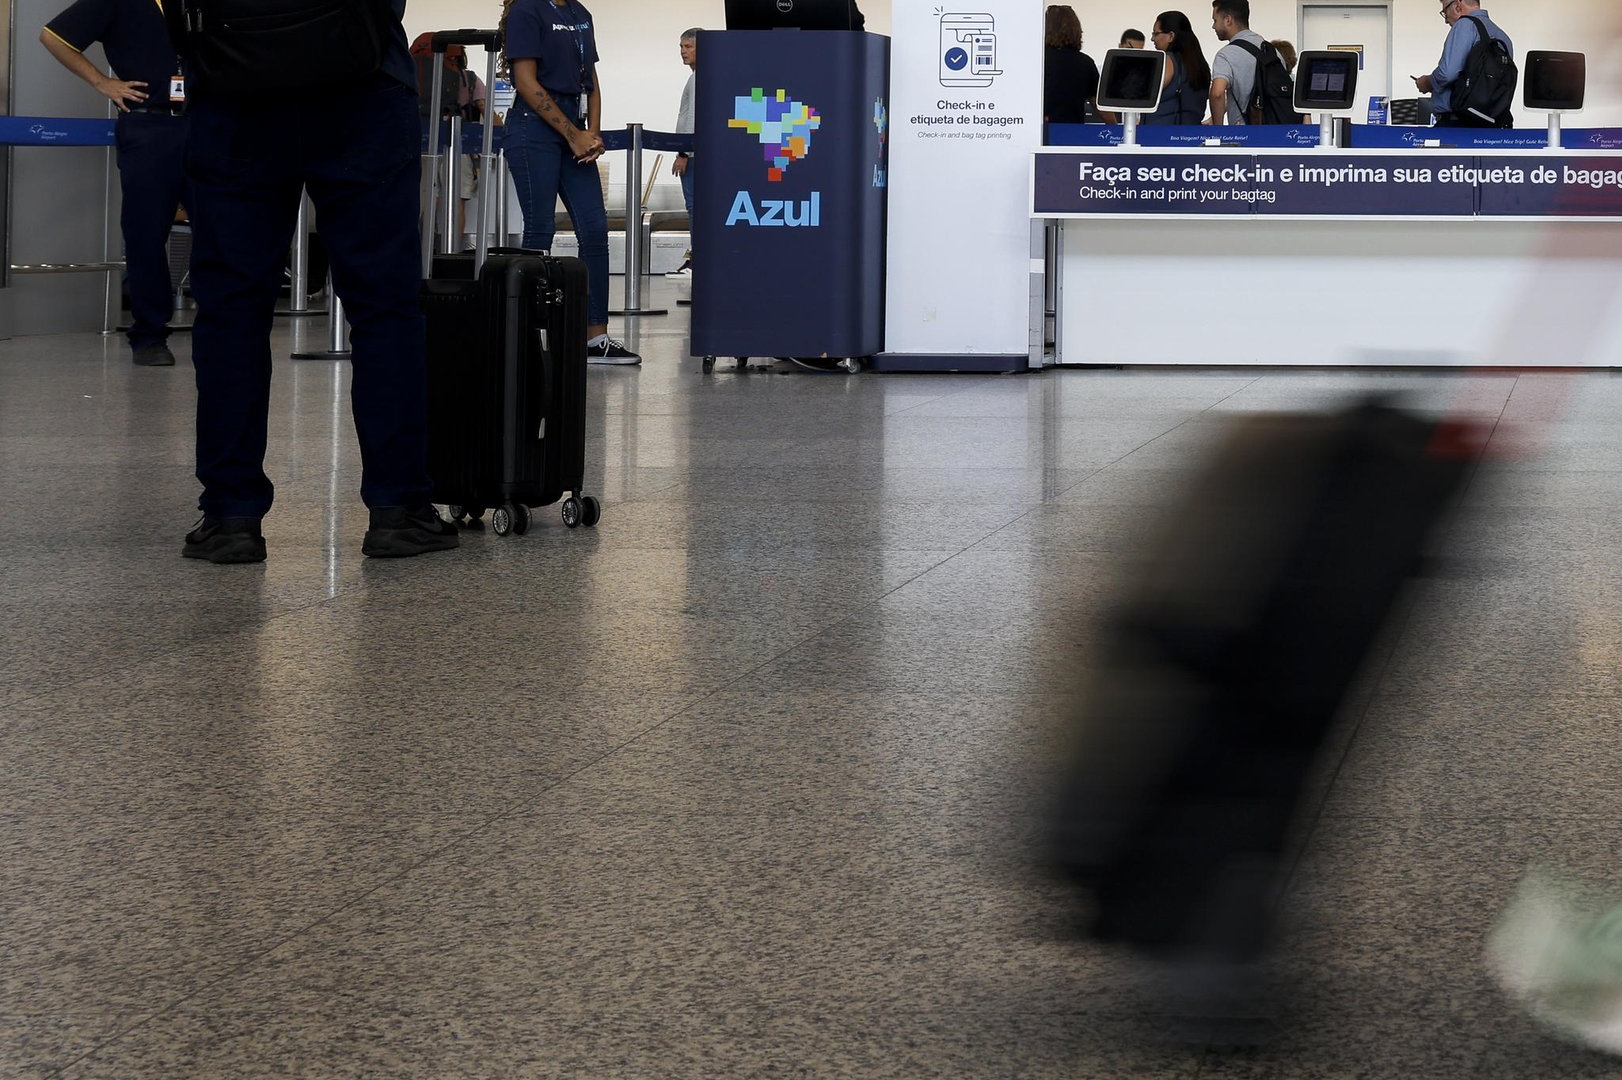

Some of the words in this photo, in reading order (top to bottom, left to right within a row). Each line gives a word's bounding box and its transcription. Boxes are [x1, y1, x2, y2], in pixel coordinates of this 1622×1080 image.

[937, 100, 985, 109] Check-in
[911, 115, 953, 126] etiqueta
[957, 115, 970, 124] de
[973, 115, 1023, 126] bagagem
[917, 131, 947, 139] Check-in
[948, 131, 960, 139] and
[961, 131, 974, 140] bag
[975, 131, 986, 140] tag
[986, 131, 1012, 140] printing
[1080, 163, 1130, 189] Faça
[1137, 168, 1175, 183] seu
[1182, 164, 1273, 183] check-in
[1280, 169, 1293, 182] e
[1300, 164, 1386, 186] imprima
[1393, 169, 1431, 182] sua
[1438, 165, 1524, 187] etiqueta
[1530, 166, 1557, 183] de
[1080, 186, 1136, 198] Check-in
[1141, 188, 1164, 199] and
[1169, 188, 1196, 202] print
[1200, 191, 1228, 202] your
[1232, 188, 1275, 203] bagtag
[725, 191, 819, 226] Azul
